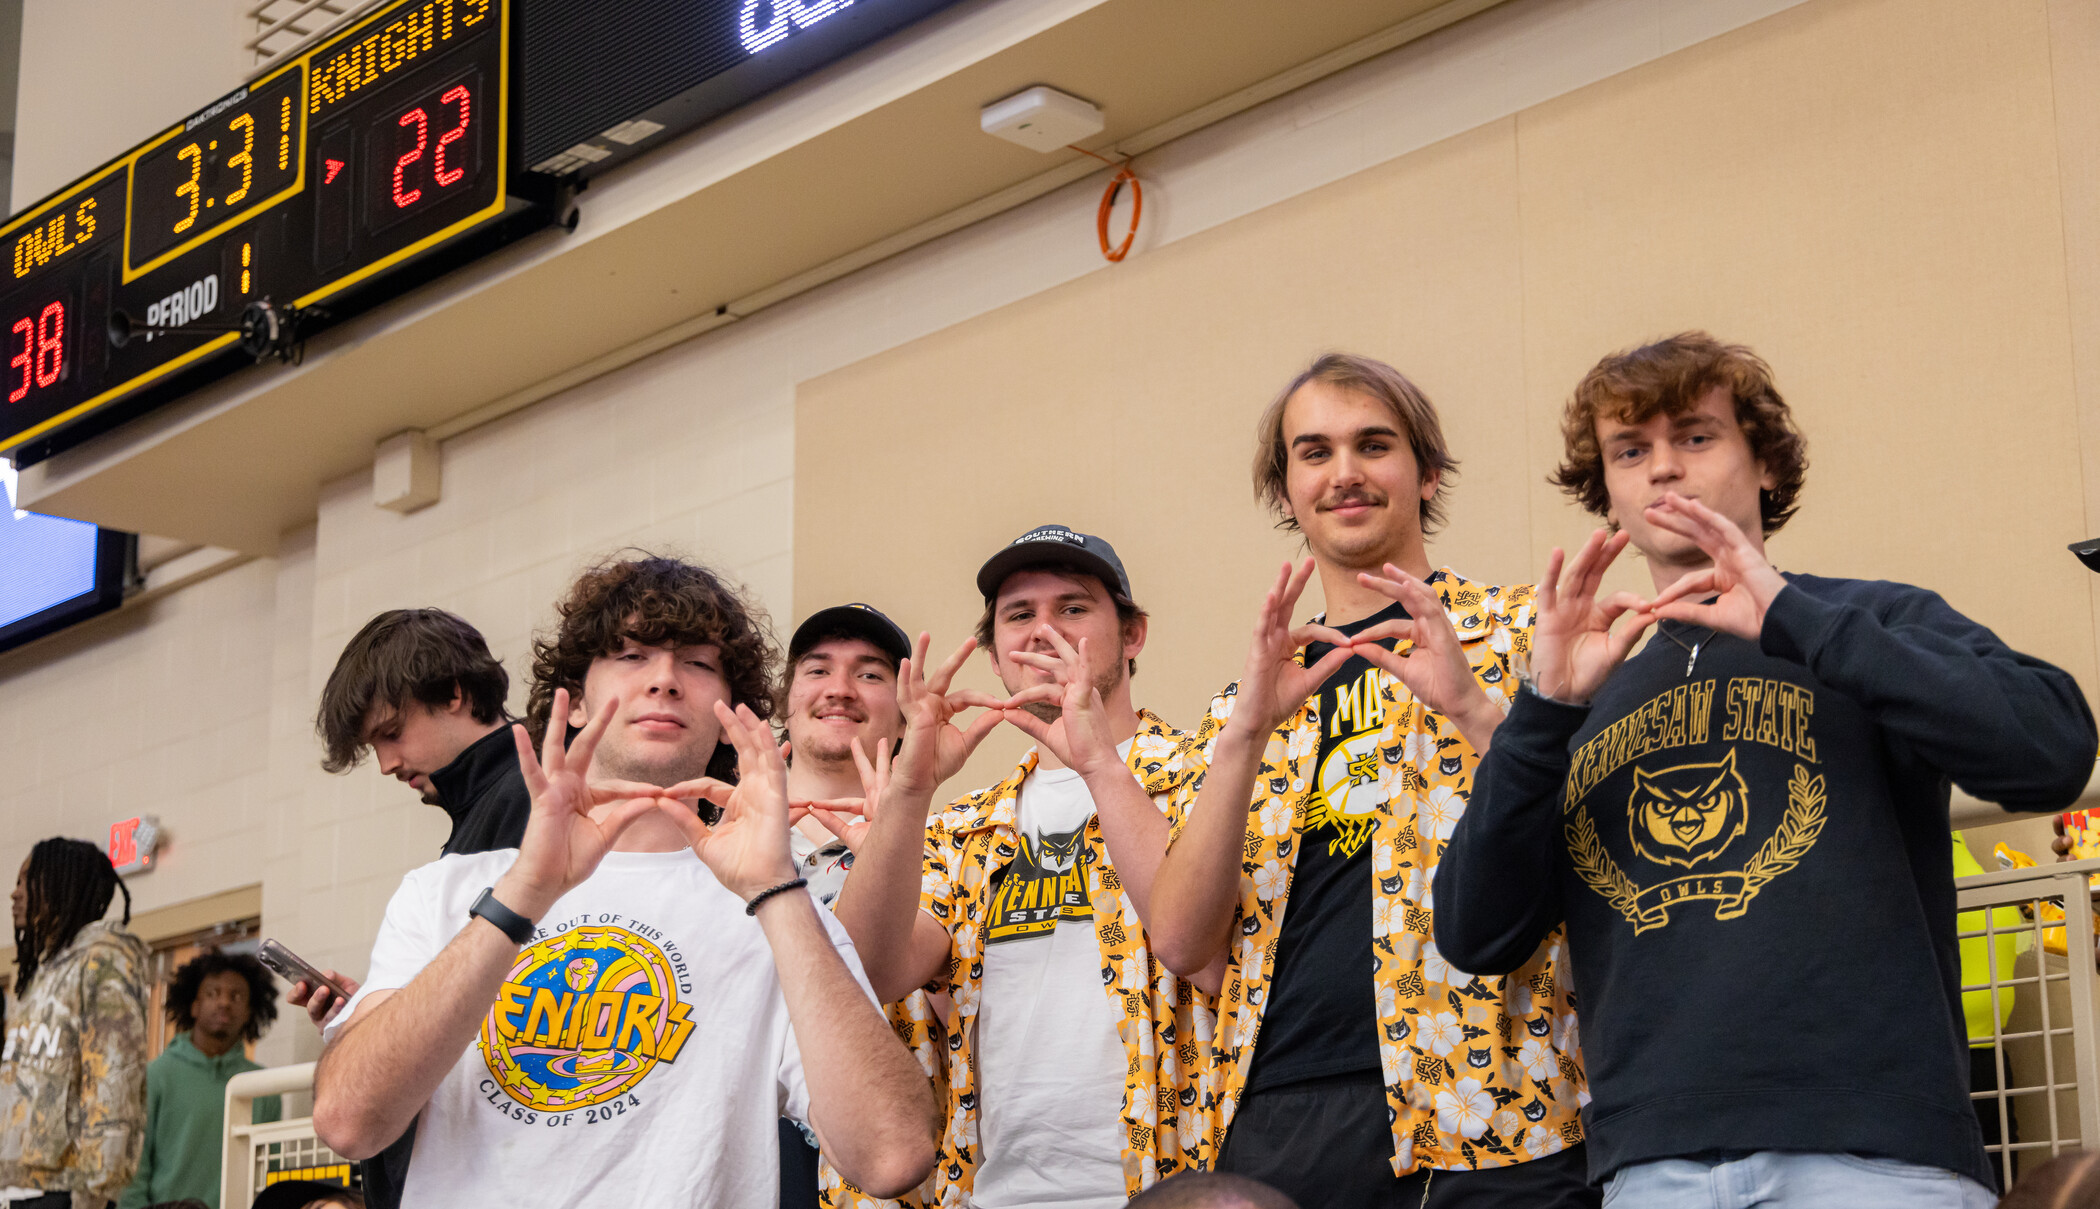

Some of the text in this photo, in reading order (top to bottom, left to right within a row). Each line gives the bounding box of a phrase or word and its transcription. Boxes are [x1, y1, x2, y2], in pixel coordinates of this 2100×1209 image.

[173, 96, 291, 233] 3:31
[393, 85, 470, 208] 22
[13, 197, 97, 278] OWLS
[241, 243, 253, 294] 1
[146, 274, 219, 342] PERIOD
[8, 301, 65, 403] 38
[1015, 529, 1085, 545] SOUTHERN
[1564, 677, 1816, 815] KENNESAW STATE
[1660, 880, 1723, 902] OWLS
[556, 914, 591, 932] OUT
[599, 913, 622, 924] OF
[628, 919, 663, 940] THIS
[663, 940, 692, 994] WORLD
[493, 980, 697, 1064] ENIORS
[479, 1079, 640, 1127] CLASS OF 2024
